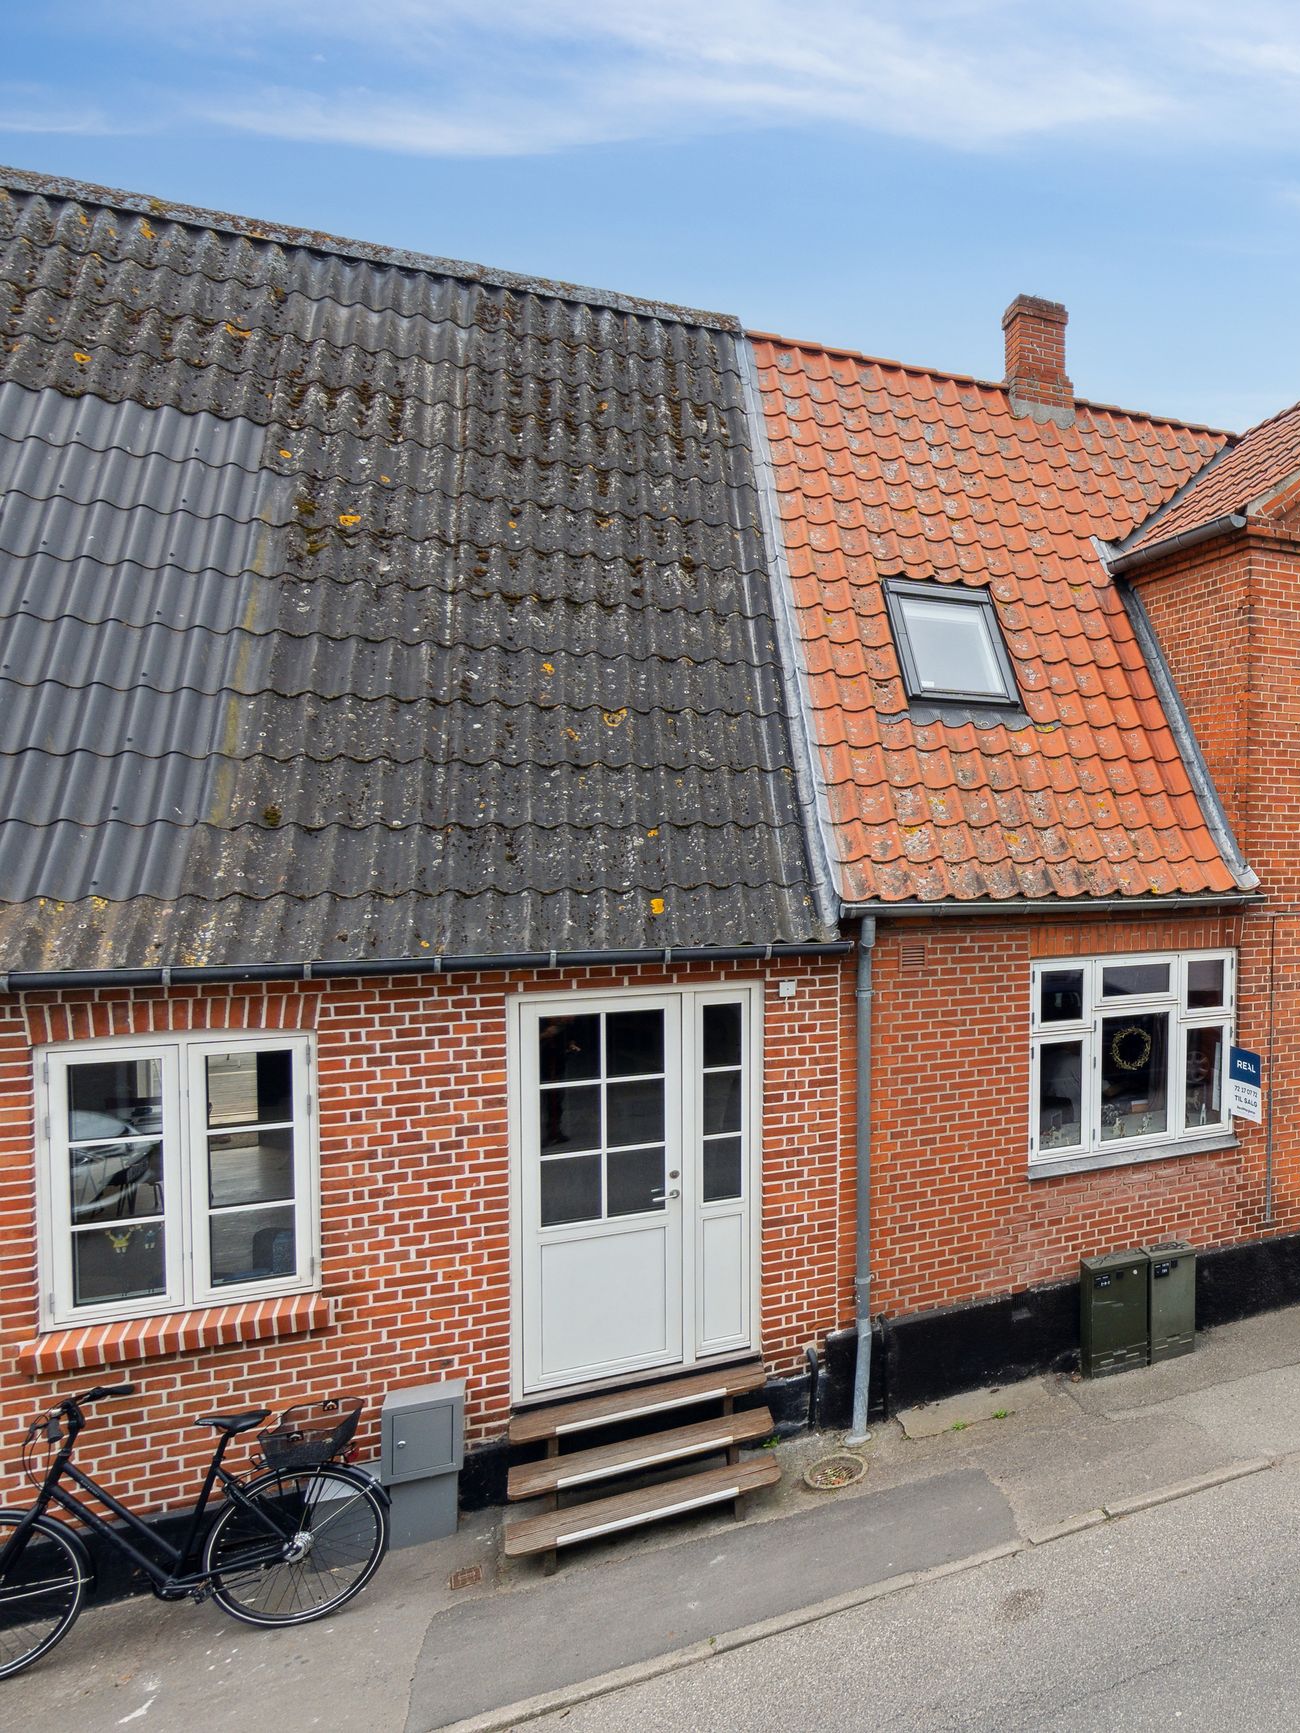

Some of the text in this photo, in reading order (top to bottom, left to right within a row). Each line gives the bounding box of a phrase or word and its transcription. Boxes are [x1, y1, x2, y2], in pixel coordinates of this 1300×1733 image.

[1236, 1059, 1256, 1074] REAL
[1234, 1094, 1258, 1108] TIL SALG
